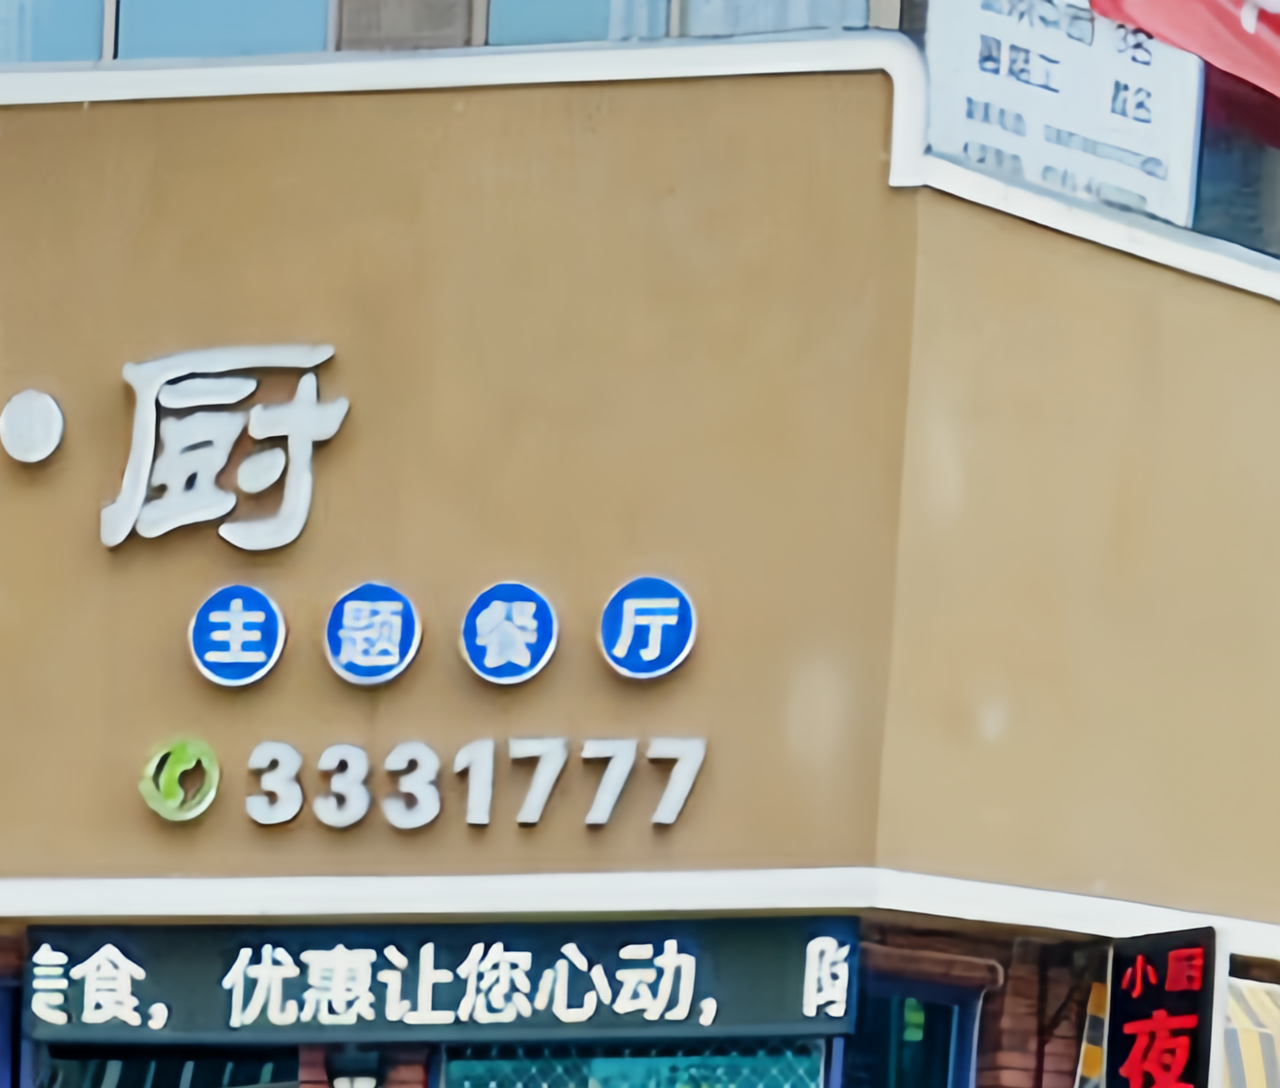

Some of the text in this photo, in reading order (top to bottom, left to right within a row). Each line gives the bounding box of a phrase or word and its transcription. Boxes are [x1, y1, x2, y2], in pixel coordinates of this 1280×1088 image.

[203, 597, 680, 668] 主题餐厅
[245, 737, 707, 829] 3331777
